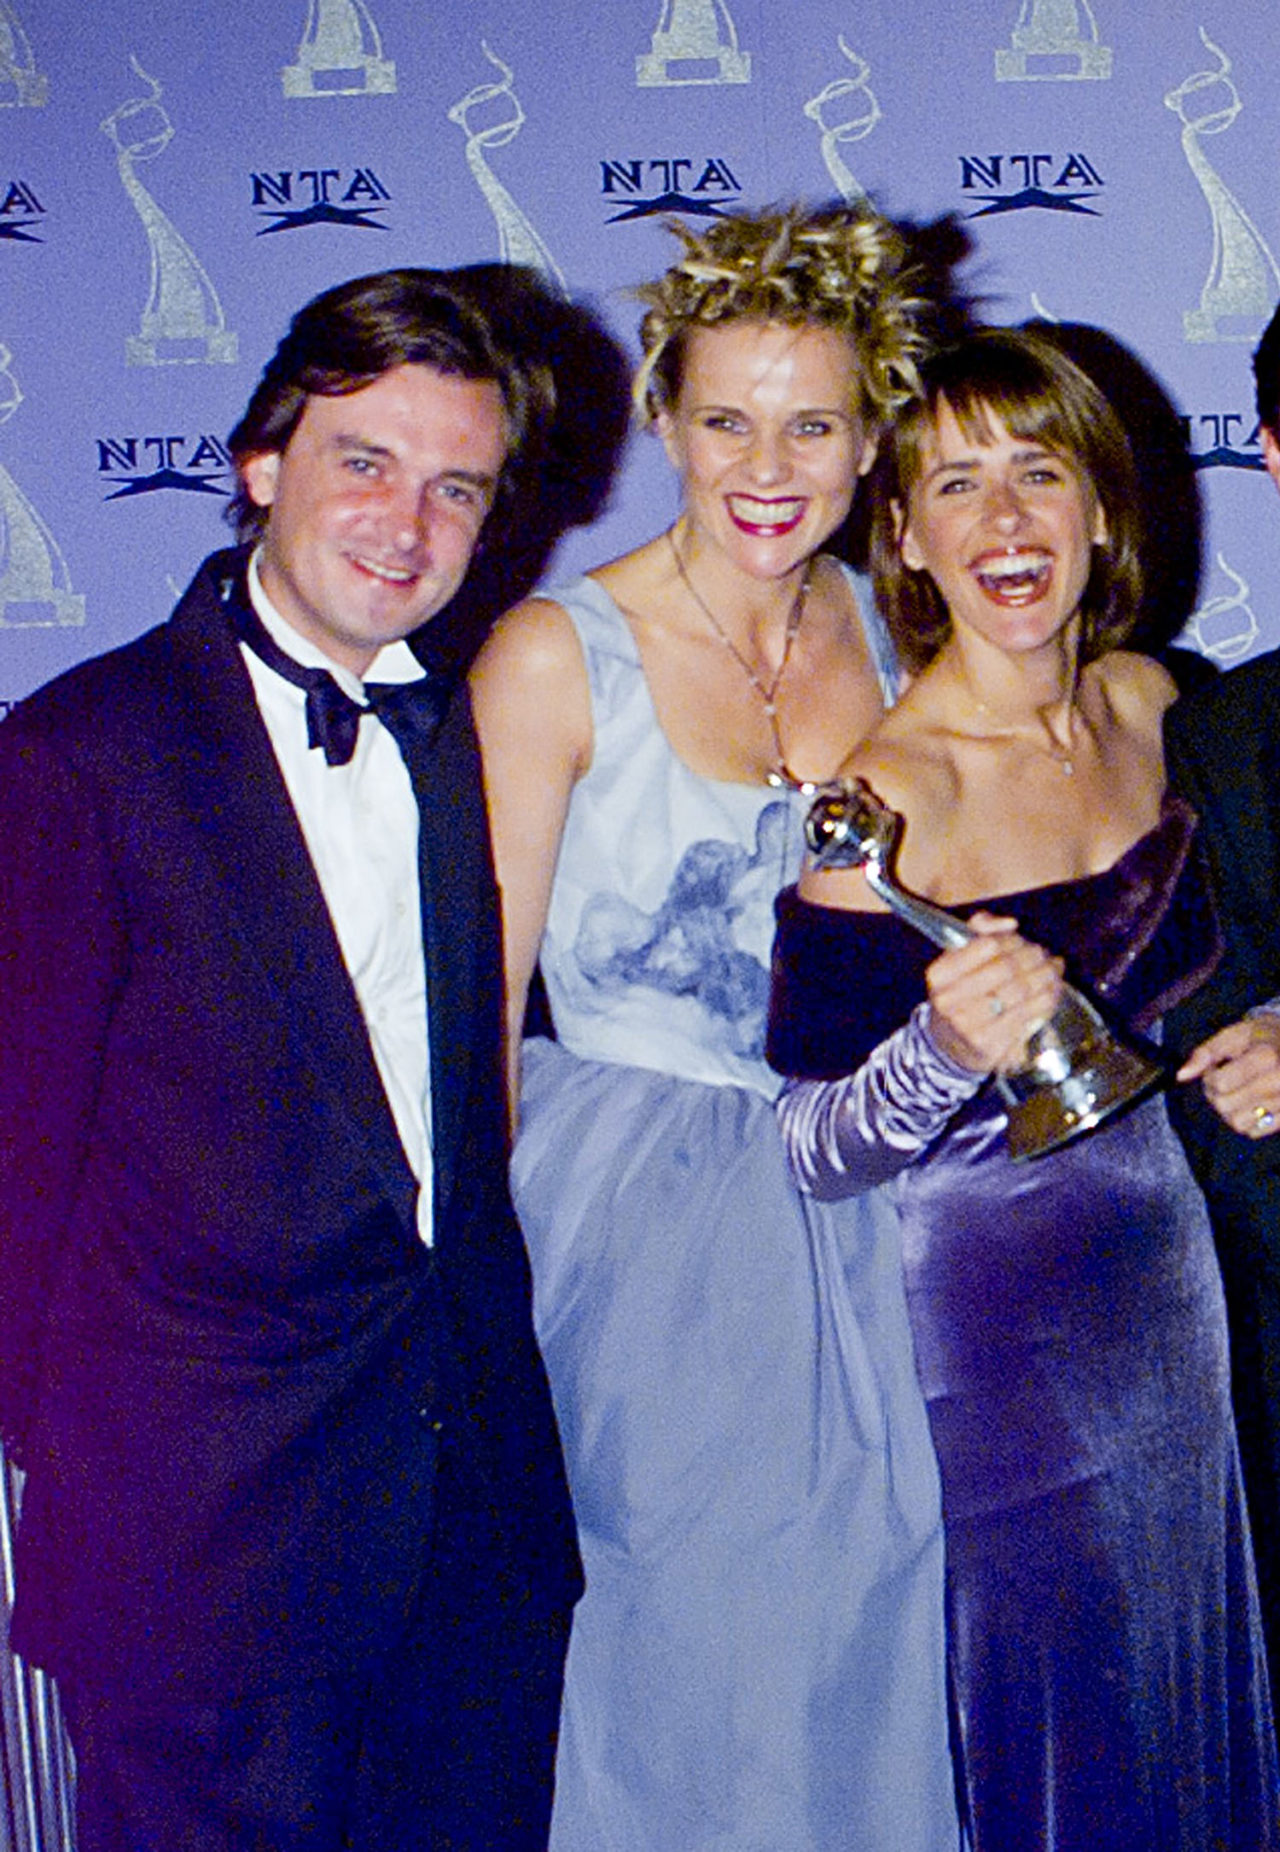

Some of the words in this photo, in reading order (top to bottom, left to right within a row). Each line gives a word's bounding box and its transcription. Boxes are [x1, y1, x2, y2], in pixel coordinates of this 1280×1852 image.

[250, 168, 392, 206] NTA
[599, 158, 742, 193] NTA
[960, 153, 1104, 189] NTA
[97, 434, 234, 471] NTA
